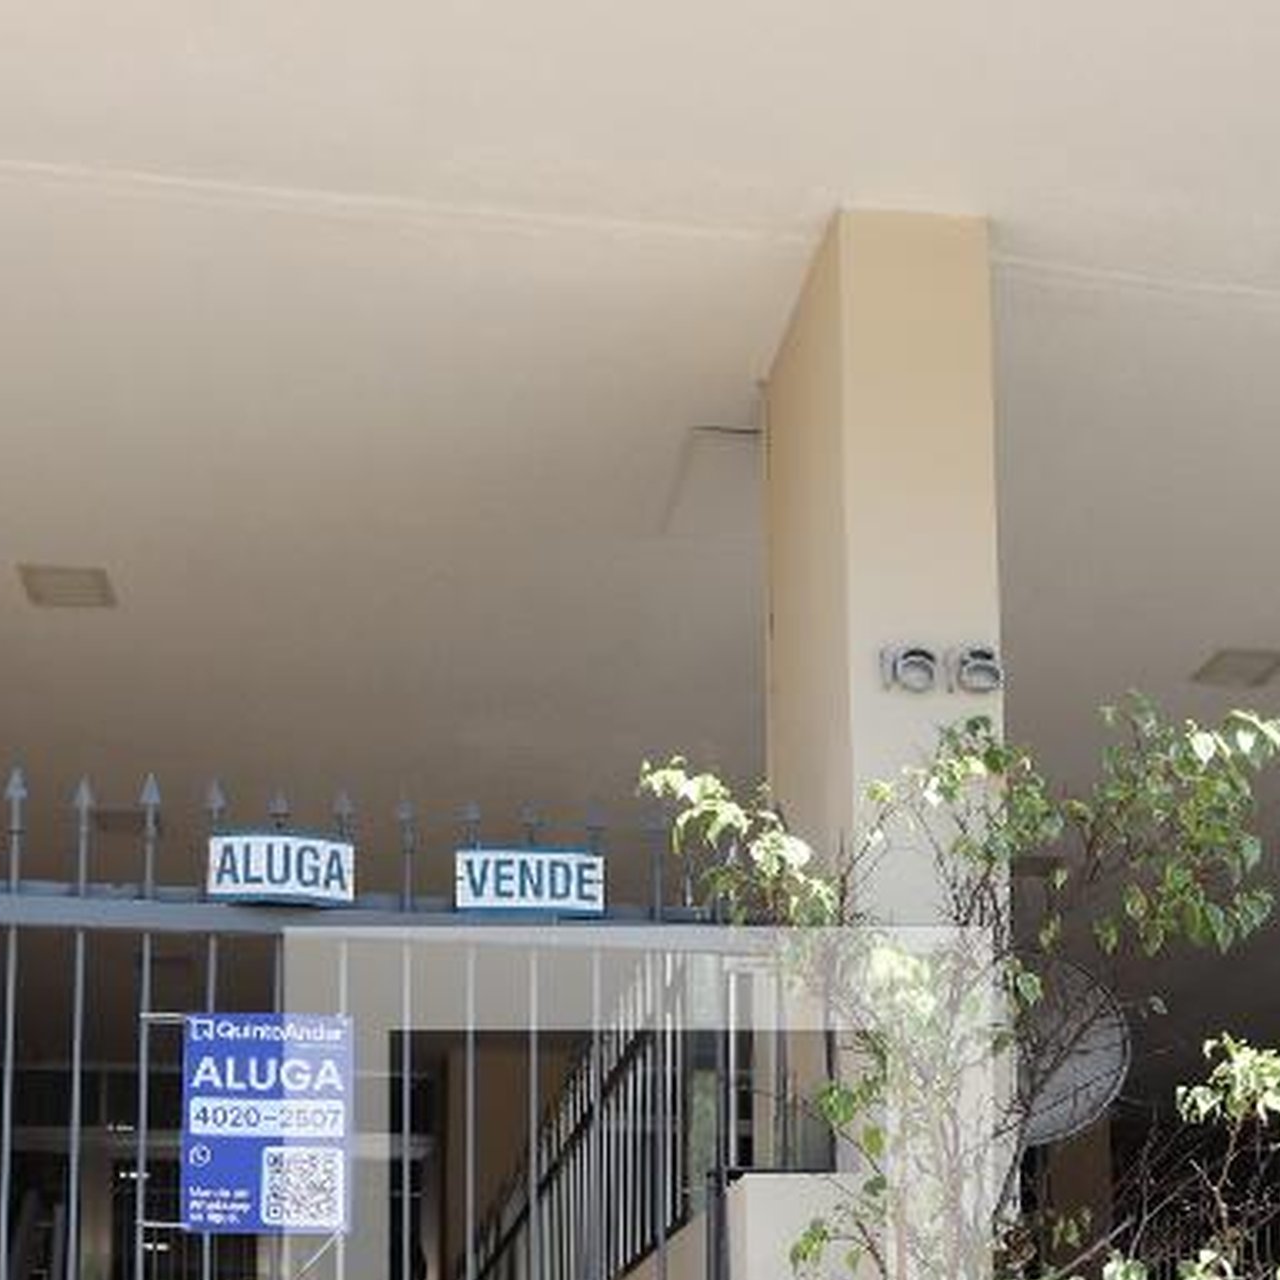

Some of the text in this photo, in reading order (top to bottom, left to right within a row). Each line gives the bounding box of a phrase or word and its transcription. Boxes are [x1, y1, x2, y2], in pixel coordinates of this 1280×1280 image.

[216, 844, 347, 890] ALUGA
[466, 858, 597, 901] VENDE
[191, 1056, 344, 1091] ALUGA
[194, 1106, 341, 1128] 4020-2507
